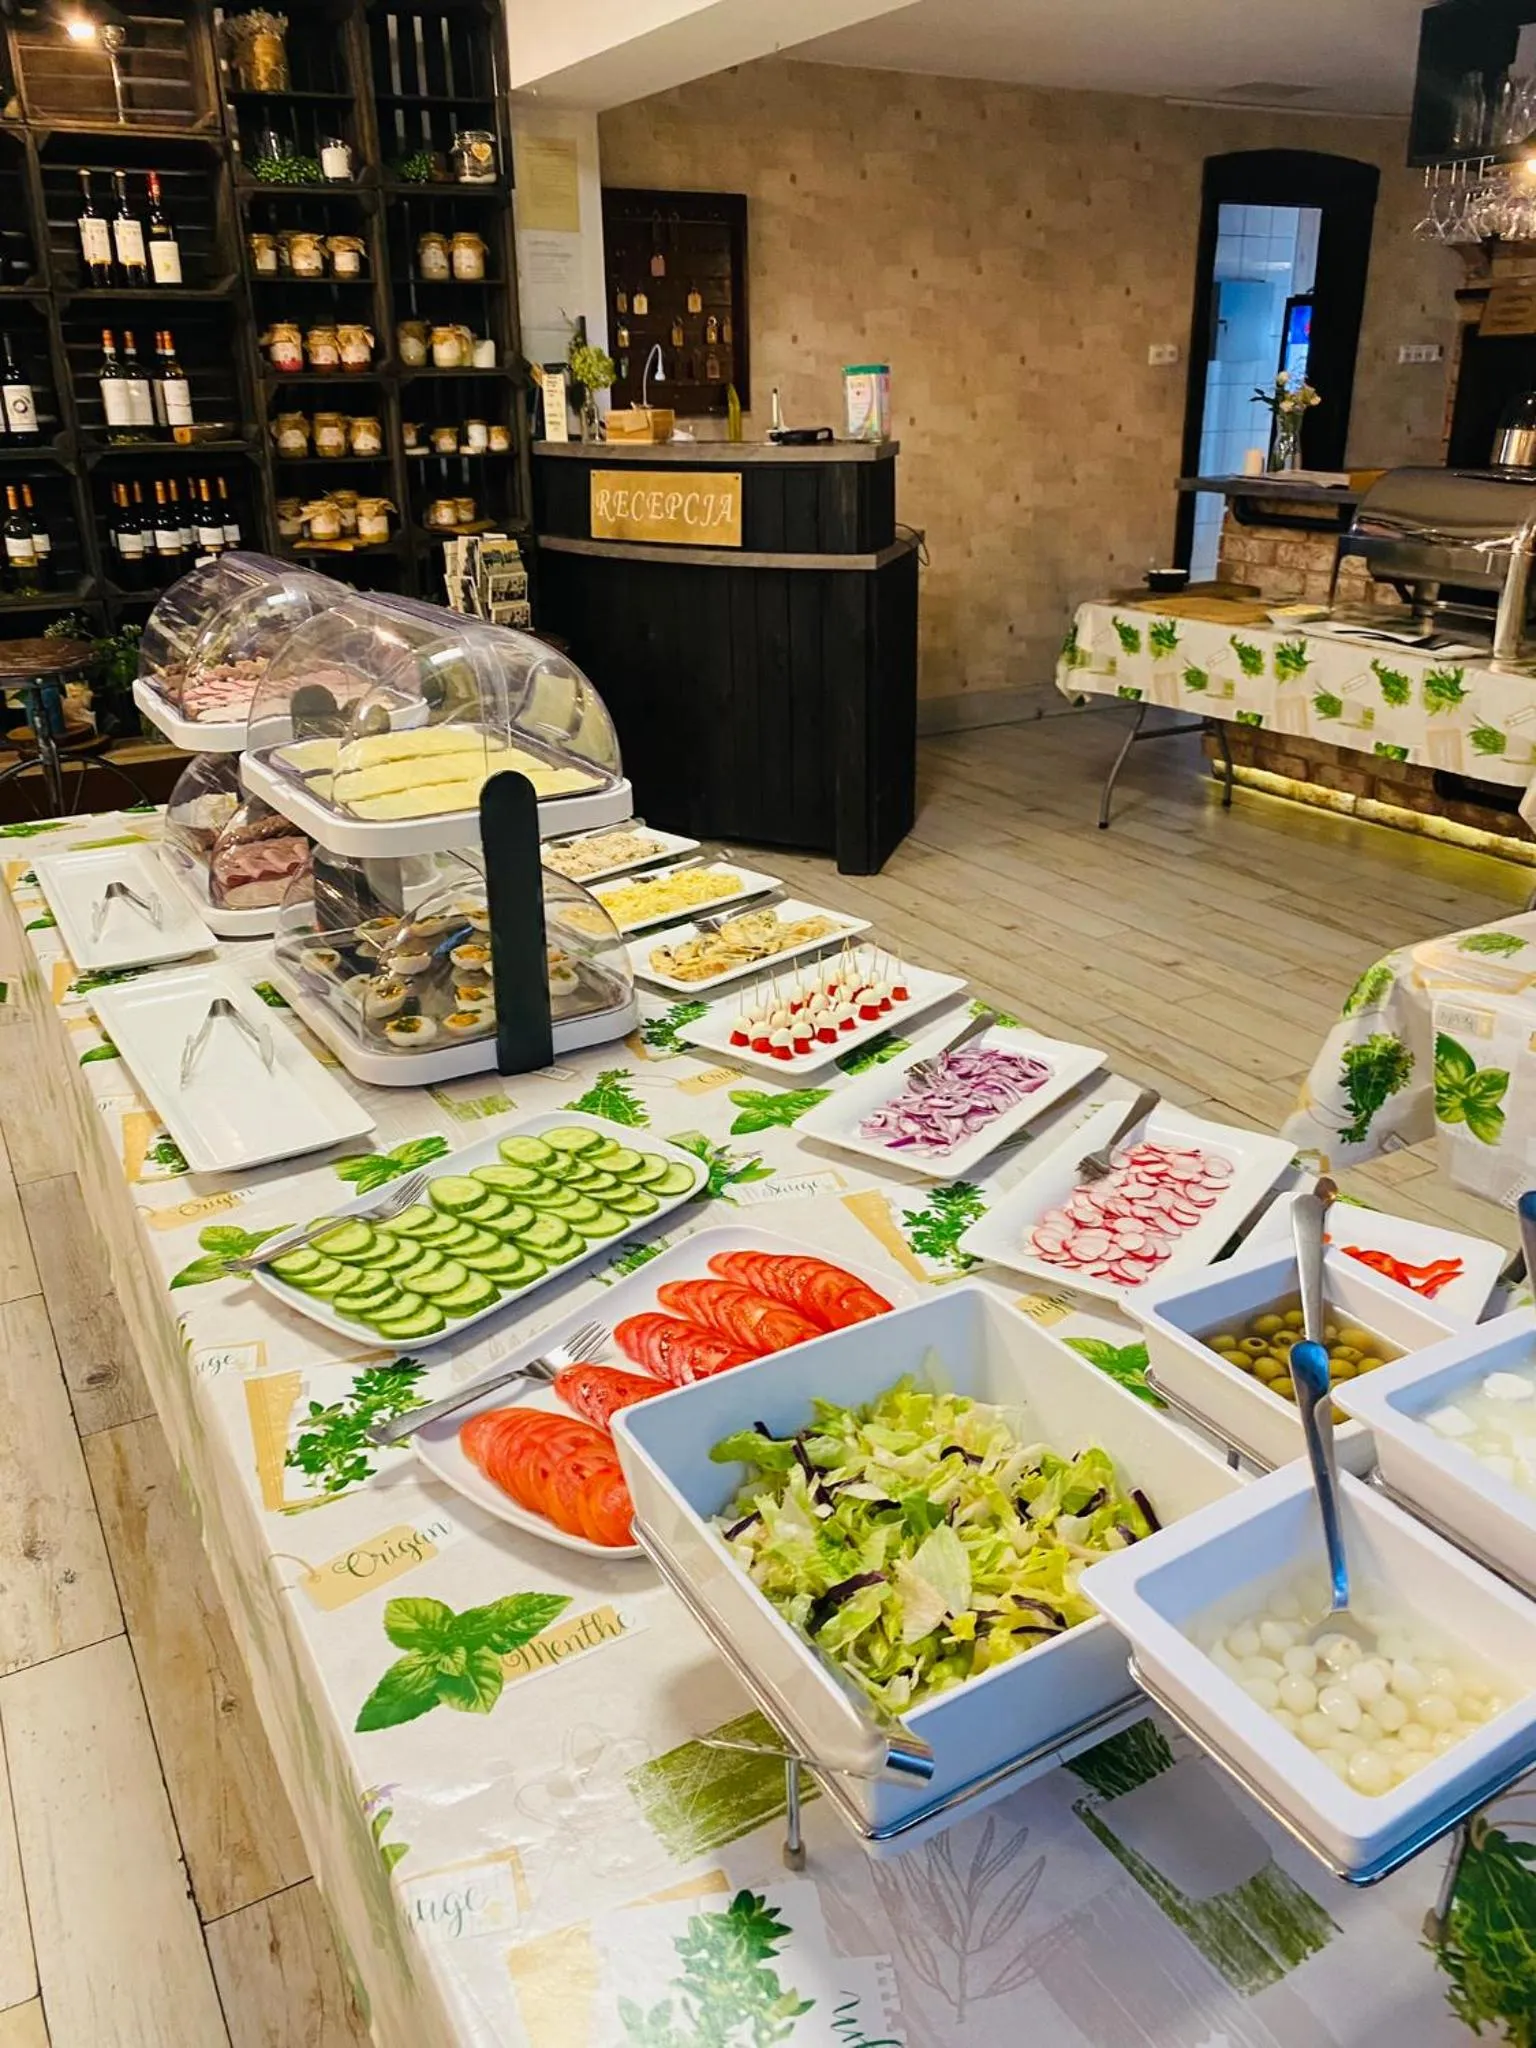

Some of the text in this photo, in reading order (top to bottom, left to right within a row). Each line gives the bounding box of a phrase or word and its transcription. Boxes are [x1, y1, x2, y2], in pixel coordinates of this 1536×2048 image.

[595, 488, 733, 527] RECEPCJA
[332, 1520, 453, 1578] Origan
[501, 1610, 636, 1671] Menthe
